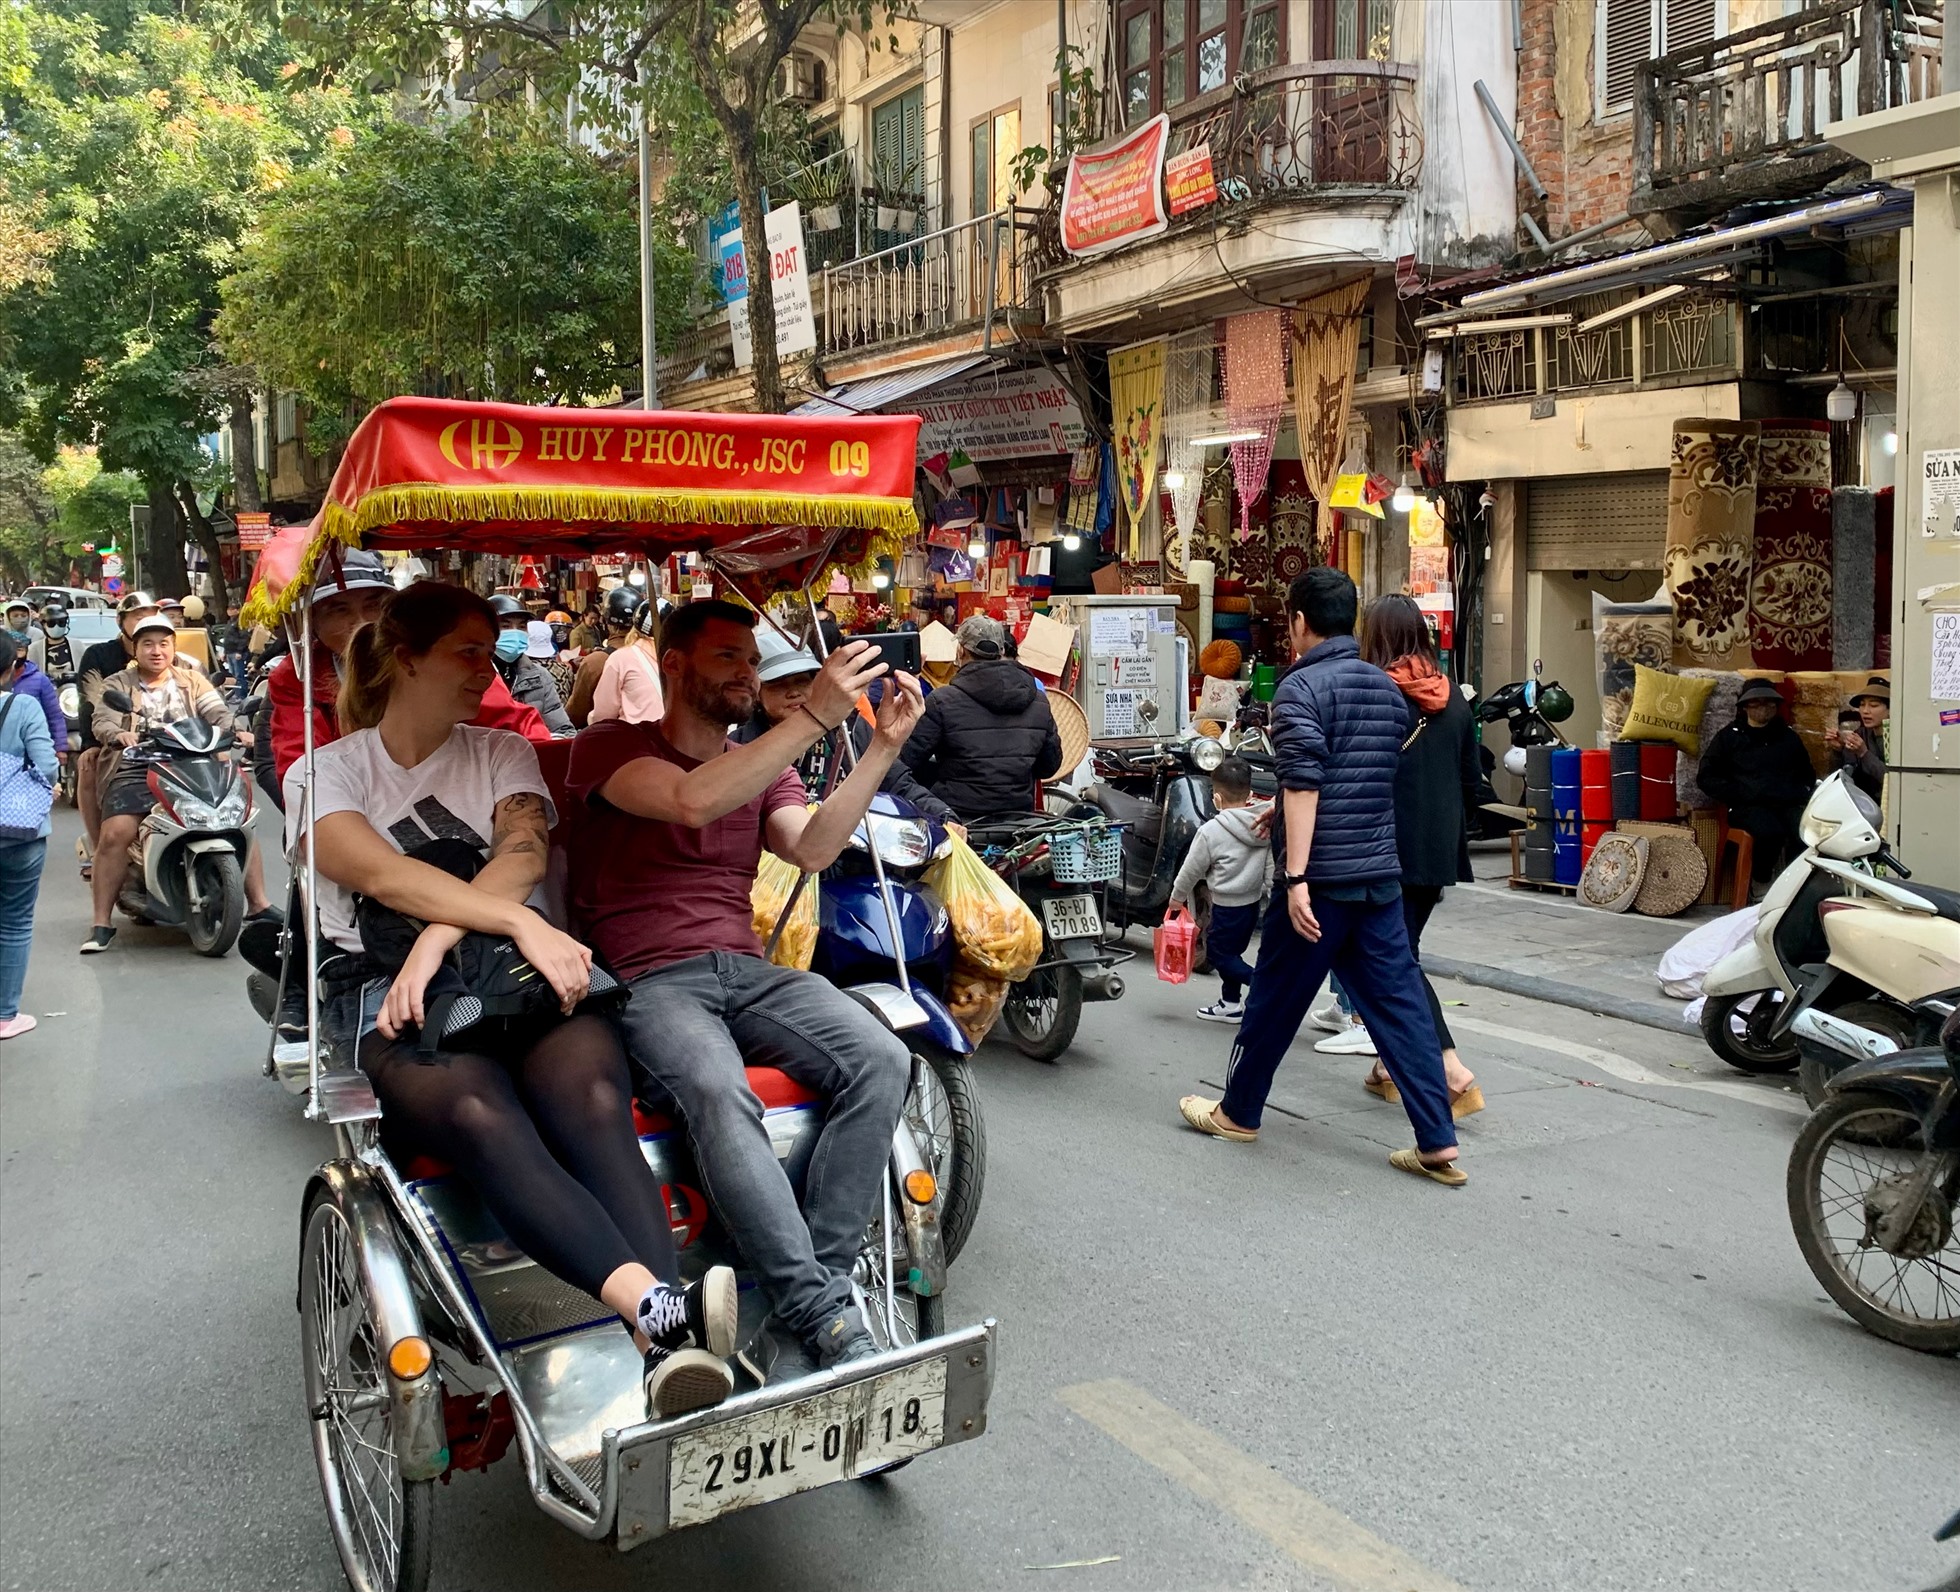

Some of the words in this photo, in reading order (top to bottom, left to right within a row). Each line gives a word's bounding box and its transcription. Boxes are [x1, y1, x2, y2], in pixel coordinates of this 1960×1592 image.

[725, 253, 744, 282] 81B
[1035, 384, 1068, 412] NHẬT
[537, 426, 614, 462] HUY
[829, 440, 870, 478] 09
[1926, 457, 1950, 479] SỬA
[1936, 616, 1957, 630] CHO
[1632, 711, 1700, 735] BALENCIAGA
[1051, 898, 1087, 917] 36-B7
[1050, 915, 1098, 936] 570.89
